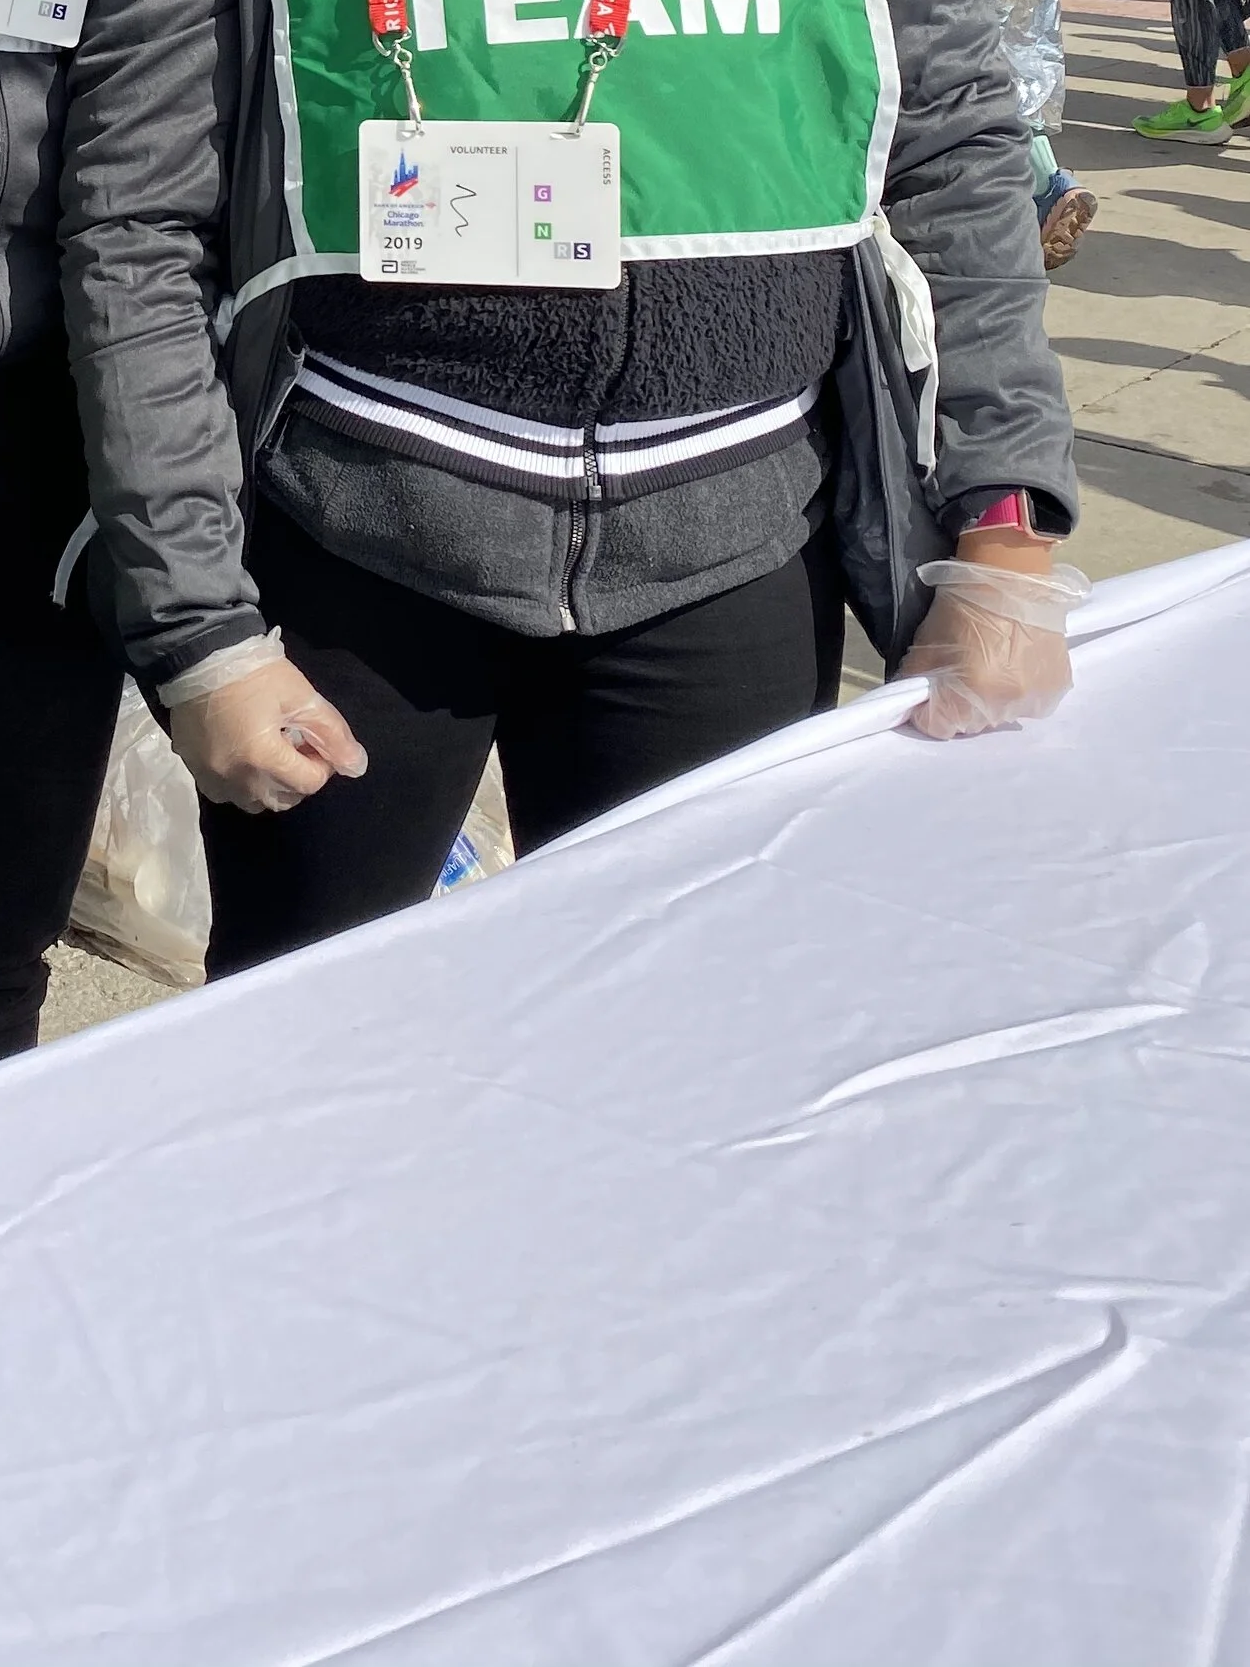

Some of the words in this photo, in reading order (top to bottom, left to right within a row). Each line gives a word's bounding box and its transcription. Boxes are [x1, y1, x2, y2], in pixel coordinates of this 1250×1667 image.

[450, 145, 508, 155] VOLUNTEER
[602, 147, 612, 186] ACCESS
[387, 210, 419, 221] Chicago
[383, 219, 424, 227] Marathon
[383, 236, 423, 250] 2019
